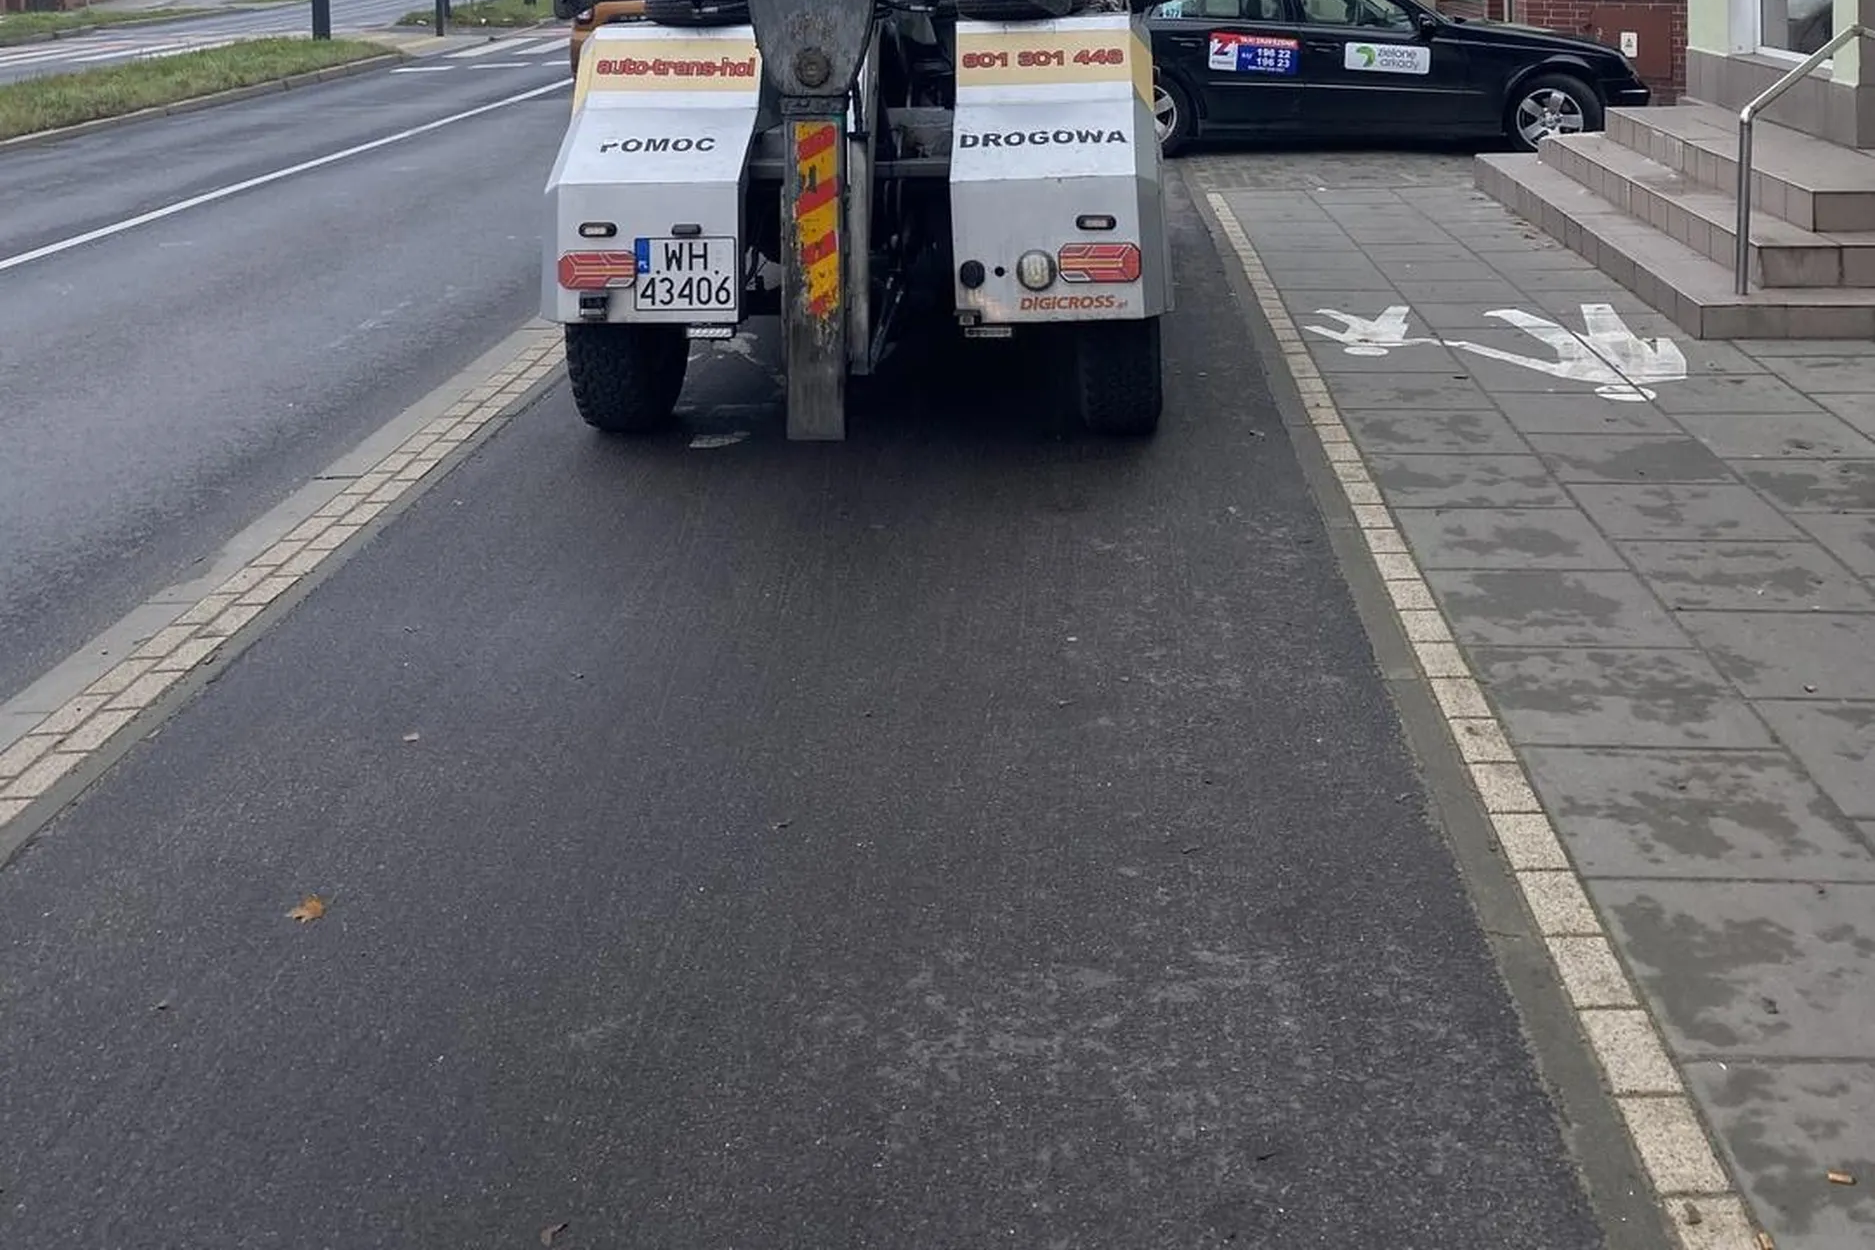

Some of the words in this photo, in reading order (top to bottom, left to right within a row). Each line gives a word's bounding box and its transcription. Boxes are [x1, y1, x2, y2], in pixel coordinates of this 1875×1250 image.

[1018, 50, 1065, 67] 301
[1277, 49, 1291, 59] 22
[1276, 58, 1291, 68] 23
[959, 130, 1128, 148] DROGOWA
[664, 242, 708, 271] WH
[640, 276, 732, 306] 43406
